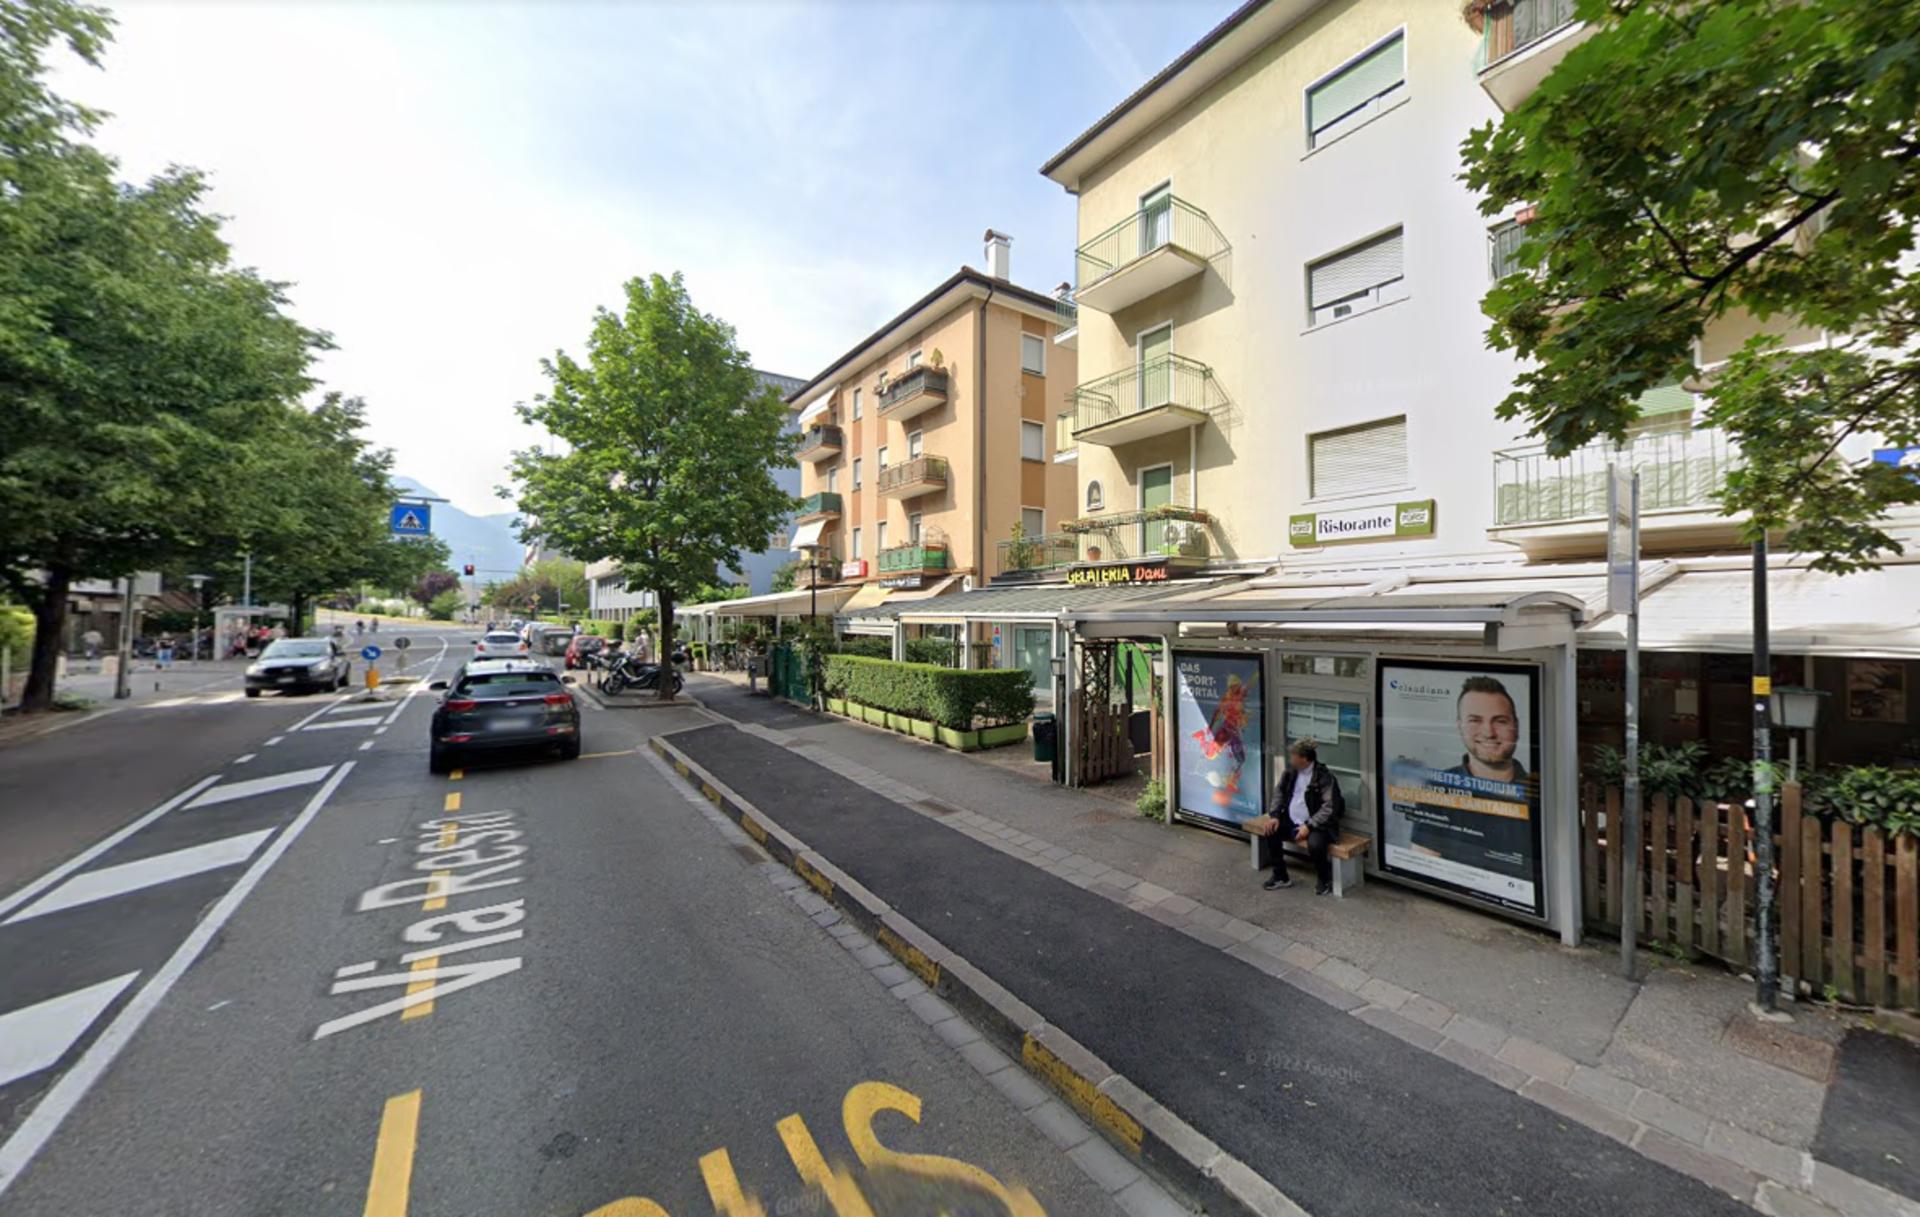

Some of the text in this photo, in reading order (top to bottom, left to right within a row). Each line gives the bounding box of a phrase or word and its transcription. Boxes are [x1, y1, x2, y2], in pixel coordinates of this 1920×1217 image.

[1319, 516, 1392, 534] Ristorante
[1067, 564, 1130, 584] GELATERIA
[1180, 663, 1200, 673] DAS
[1182, 685, 1219, 699] ORTAL
[582, 1081, 1046, 1217] US
